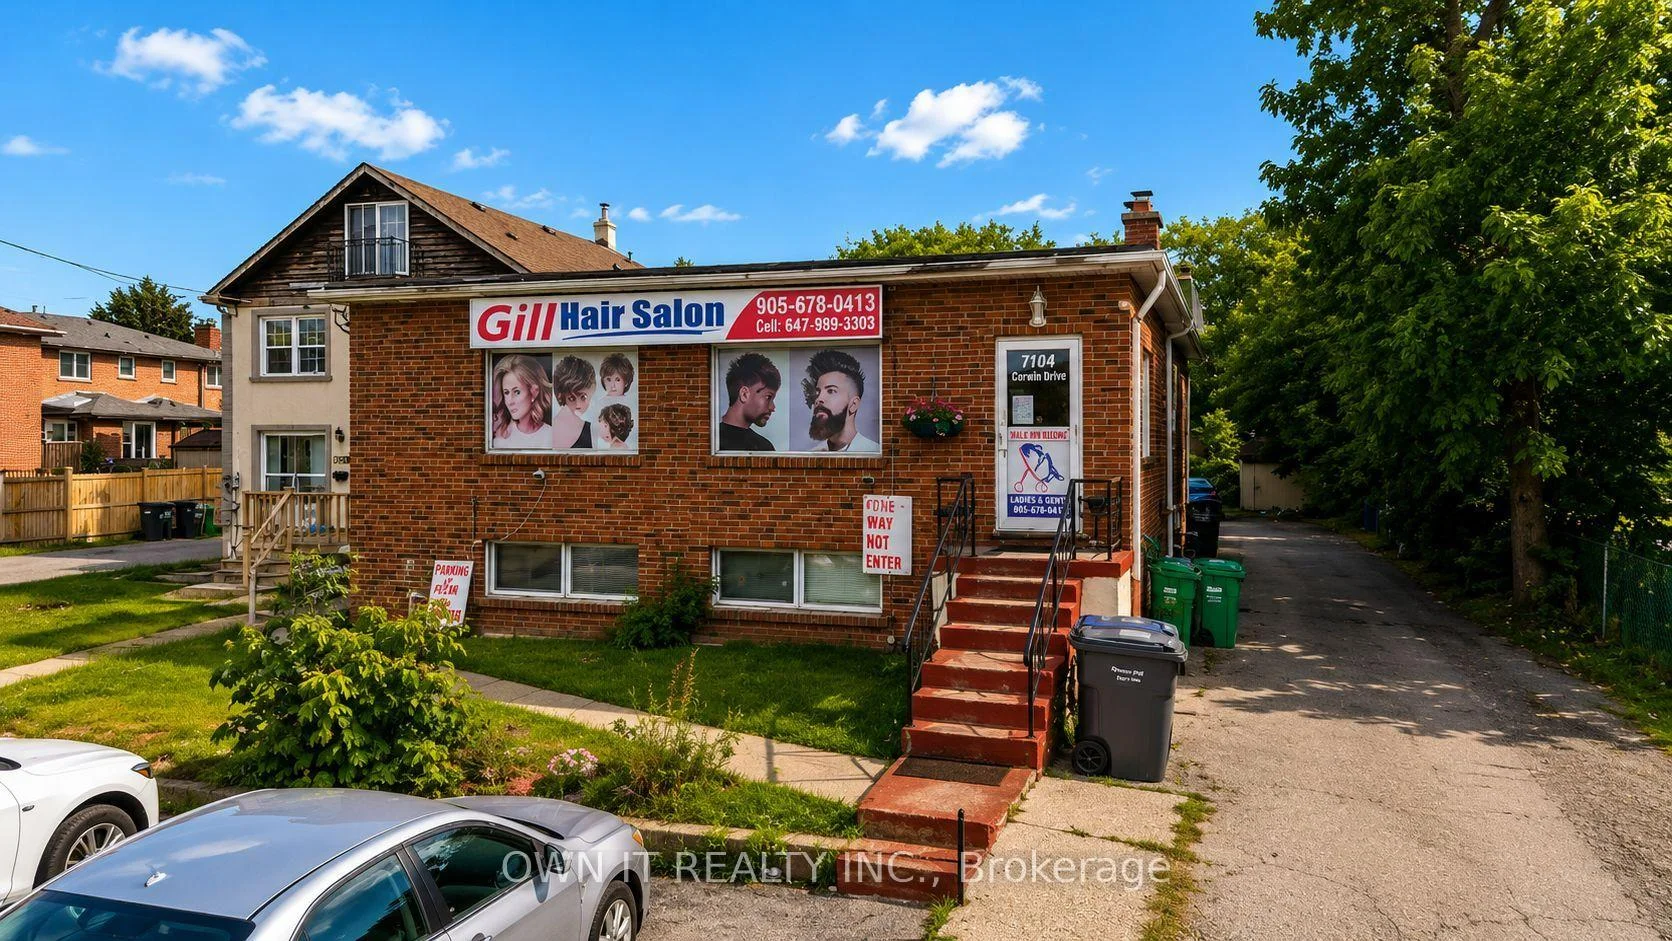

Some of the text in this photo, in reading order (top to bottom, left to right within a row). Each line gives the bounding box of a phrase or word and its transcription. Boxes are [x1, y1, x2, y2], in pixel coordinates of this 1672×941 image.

[756, 293, 875, 315] 905-678-0413
[477, 299, 724, 341] Gill Hair Salon
[756, 316, 875, 333] Cell: 647-989-3303
[1021, 354, 1055, 369] 7104
[1012, 371, 1067, 381] Corwin Drive
[1010, 496, 1037, 504] LADIES
[1045, 496, 1067, 505] GENT
[867, 516, 893, 530] WAY
[866, 534, 889, 550] NOT
[866, 554, 902, 570] ENTER
